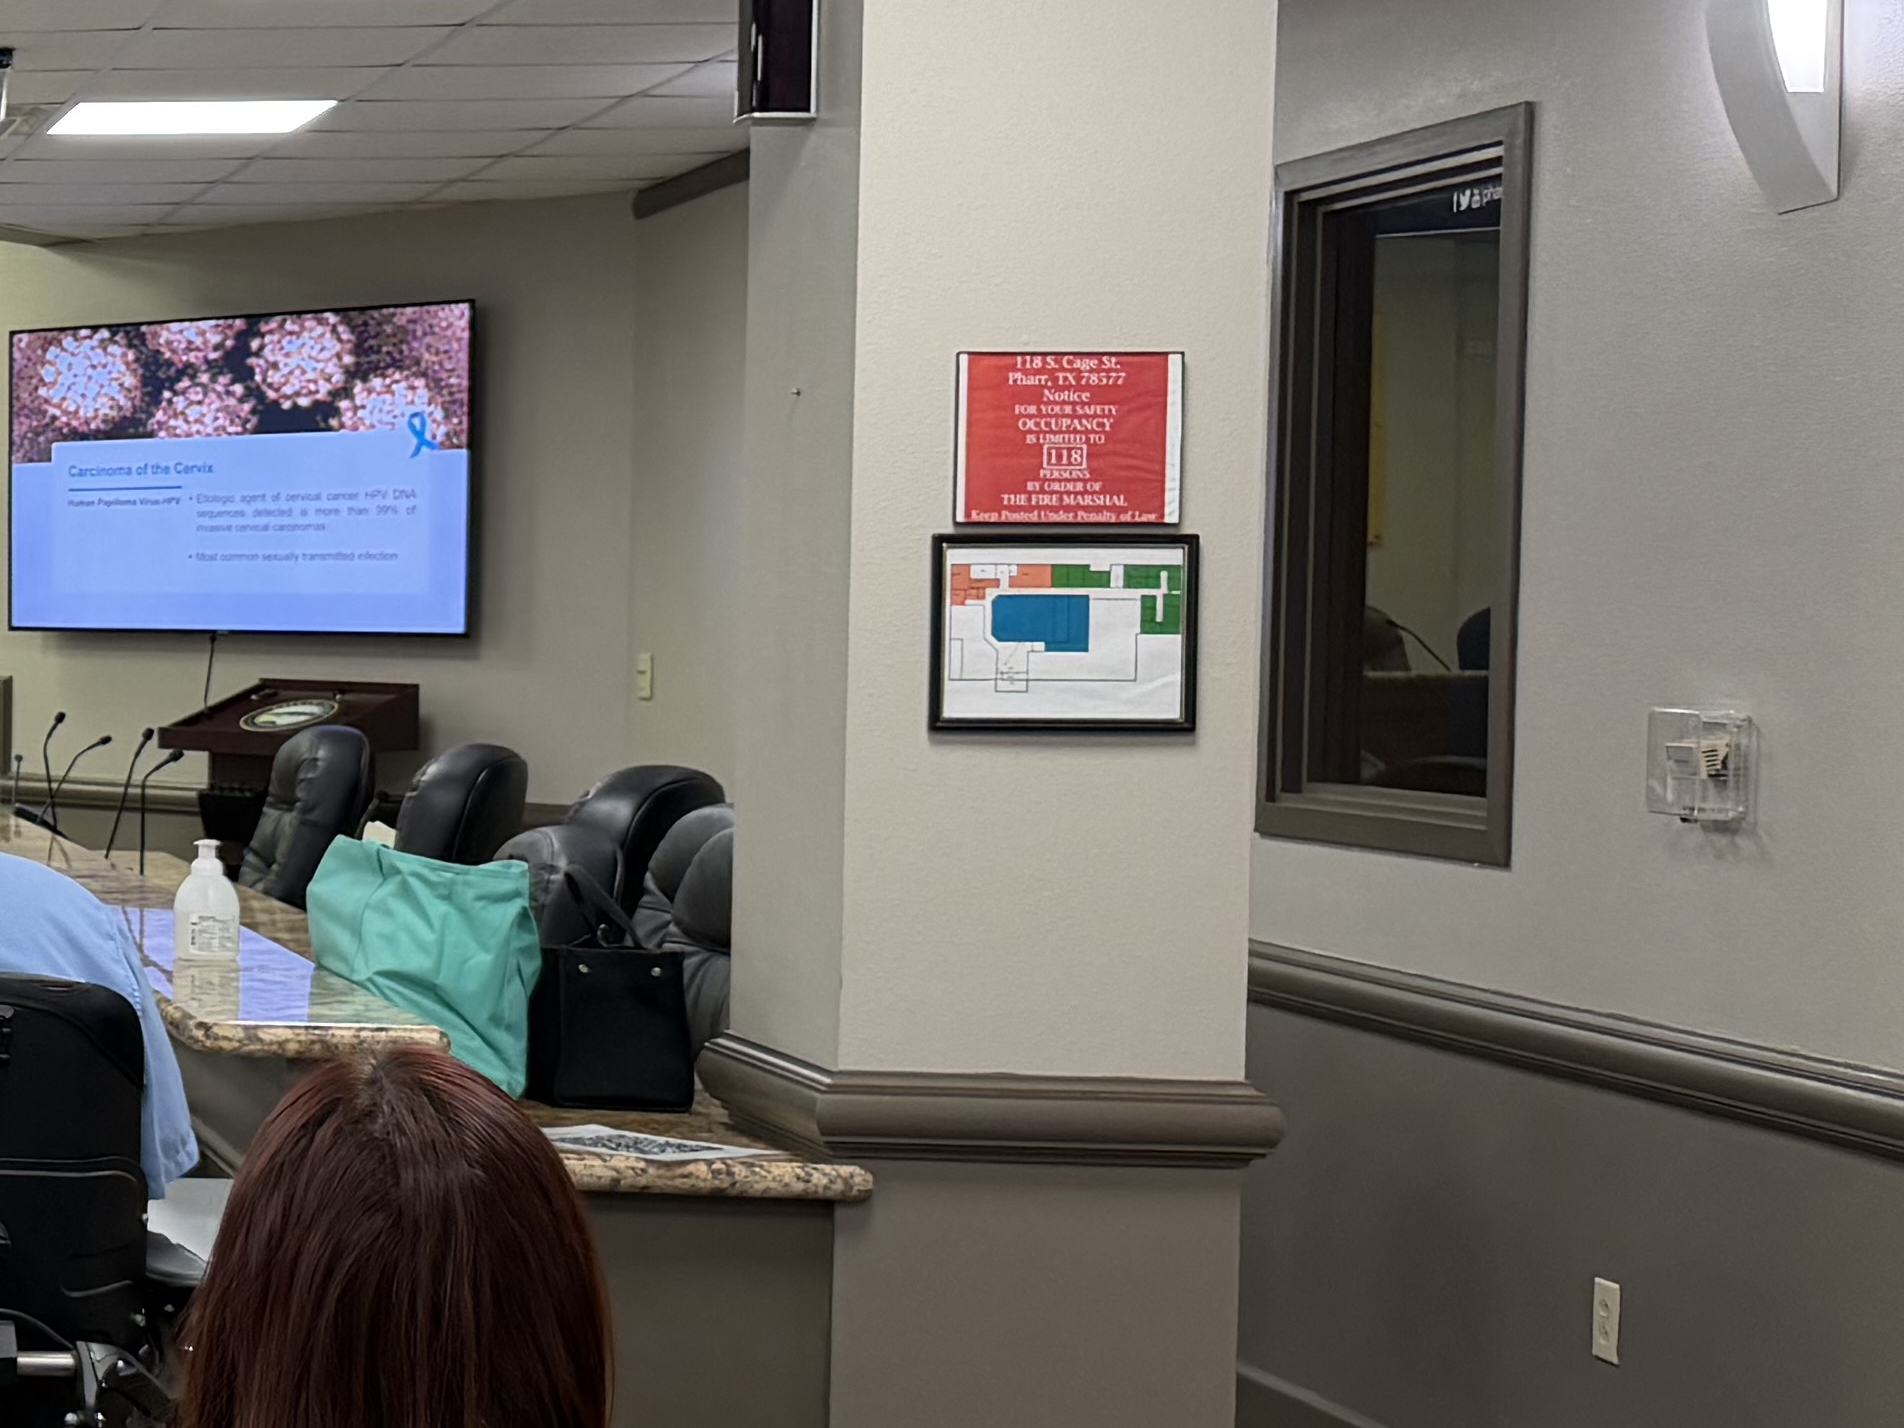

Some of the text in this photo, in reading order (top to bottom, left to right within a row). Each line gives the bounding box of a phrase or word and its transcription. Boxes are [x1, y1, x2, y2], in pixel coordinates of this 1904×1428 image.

[1016, 356, 1121, 371] 118 S. Cage St.
[1008, 372, 1126, 386] Pharr, TX 78577
[1043, 388, 1090, 402] Notice
[1015, 404, 1118, 415] FOR YOUR SAFETY
[1018, 417, 1113, 431] OCCUPANCY
[1039, 434, 1085, 444] LIMITED
[1089, 434, 1105, 444] TO
[1049, 449, 1082, 464] 118
[68, 462, 214, 477] Carcinoma of the Cervix
[1040, 469, 1090, 479] PERSONS
[1026, 481, 1102, 491] BY ORDER OF
[1000, 494, 1128, 506] THE FIRE MARSHAL
[971, 510, 1158, 522] Keep Posted Under Penalty of Law
